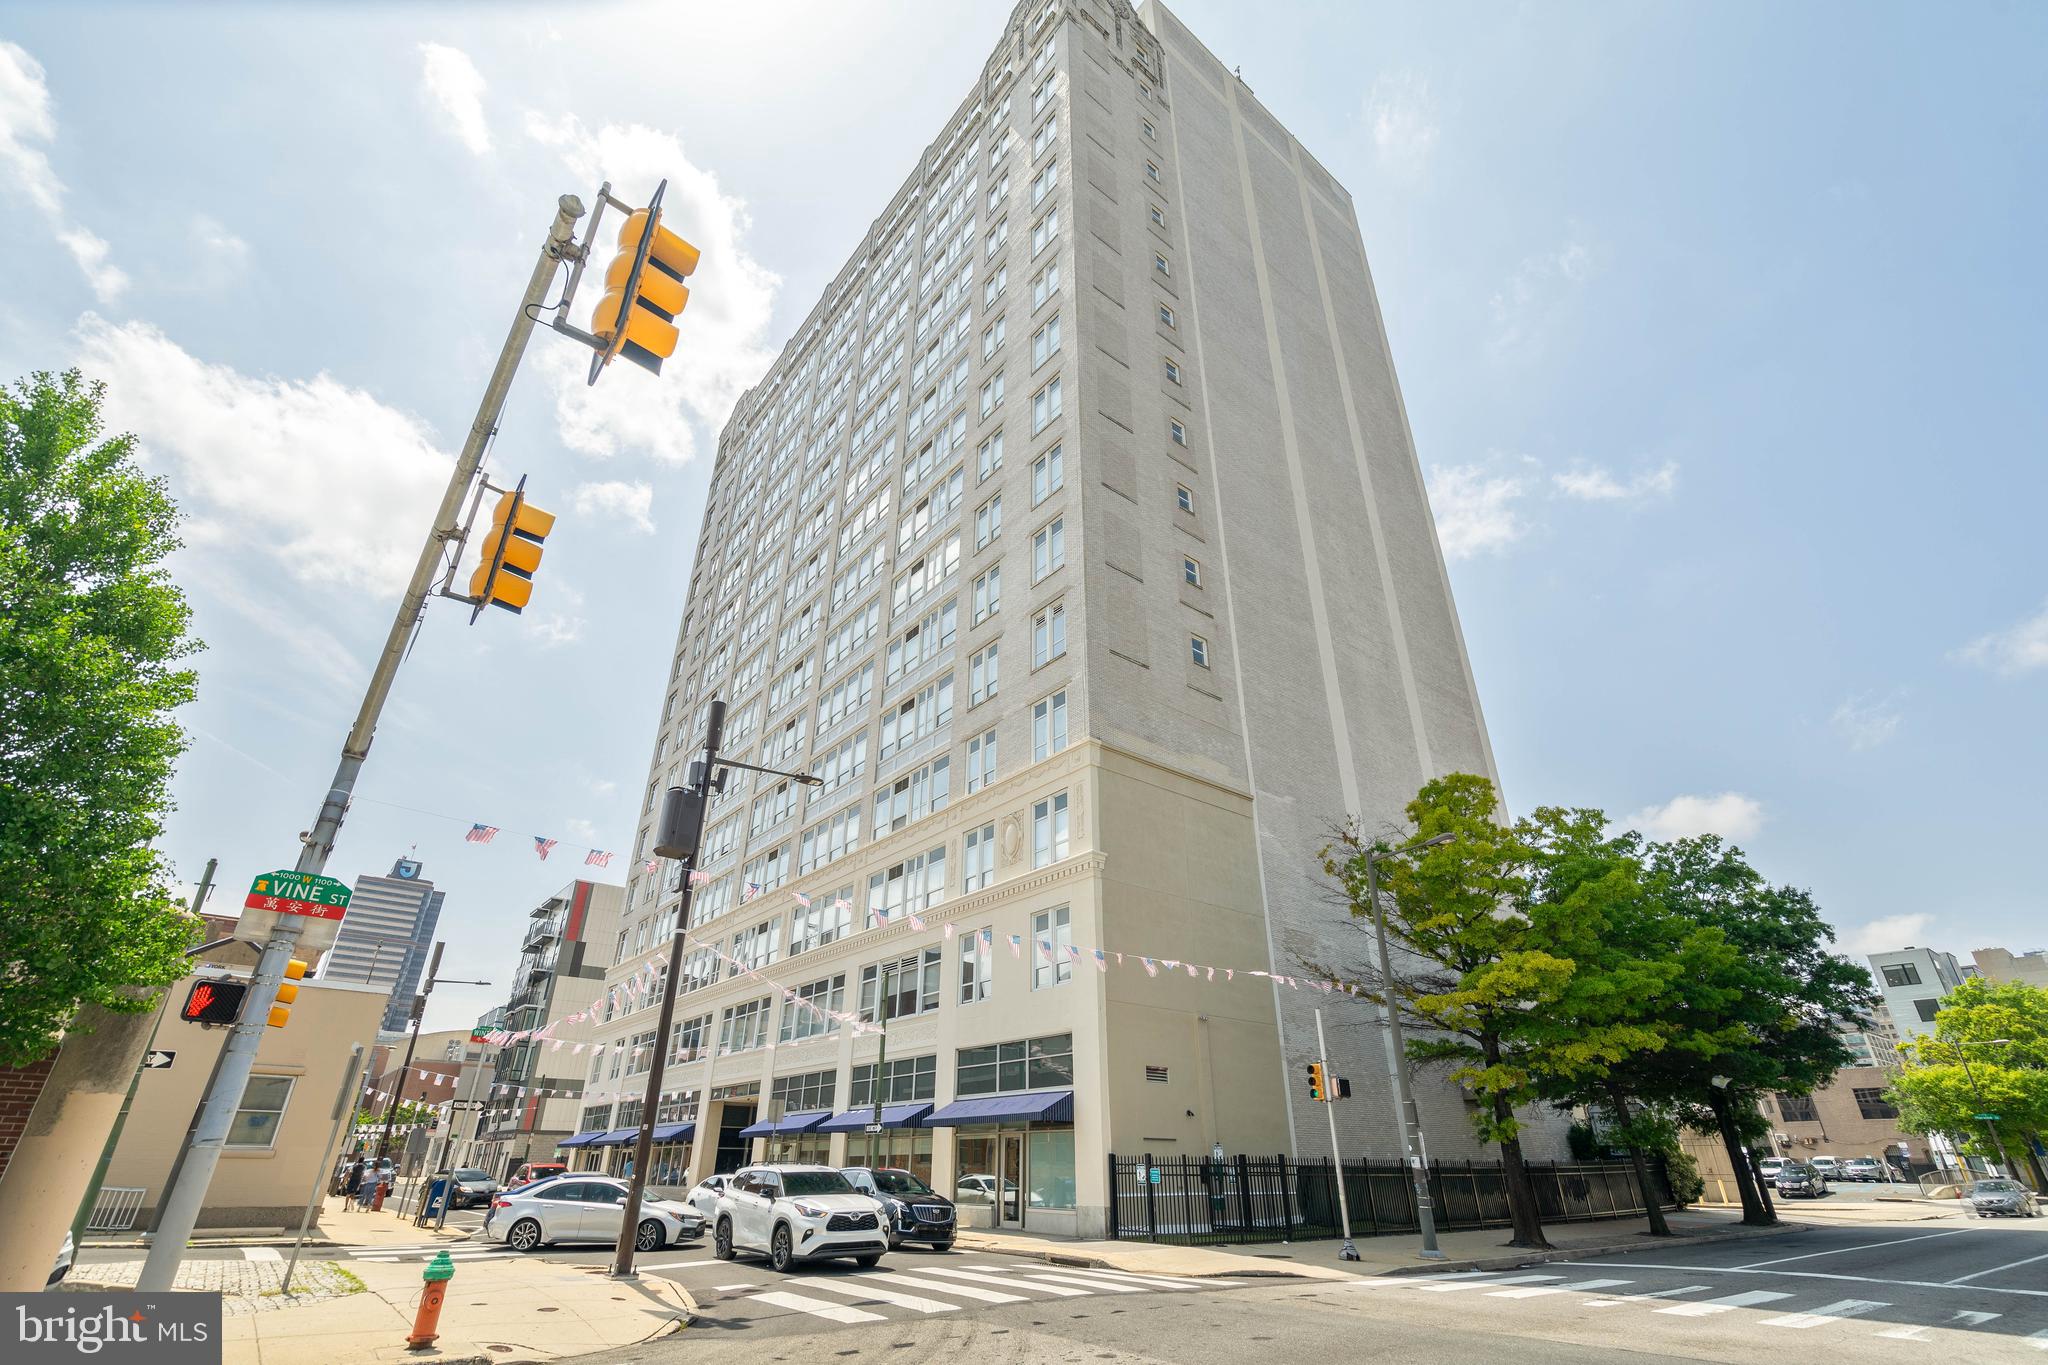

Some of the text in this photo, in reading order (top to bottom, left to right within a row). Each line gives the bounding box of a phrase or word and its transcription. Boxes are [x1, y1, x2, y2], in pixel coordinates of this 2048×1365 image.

[279, 872, 333, 887] 1000 W 1100
[273, 880, 348, 906] VINE ST
[263, 897, 329, 917] 萬安街
